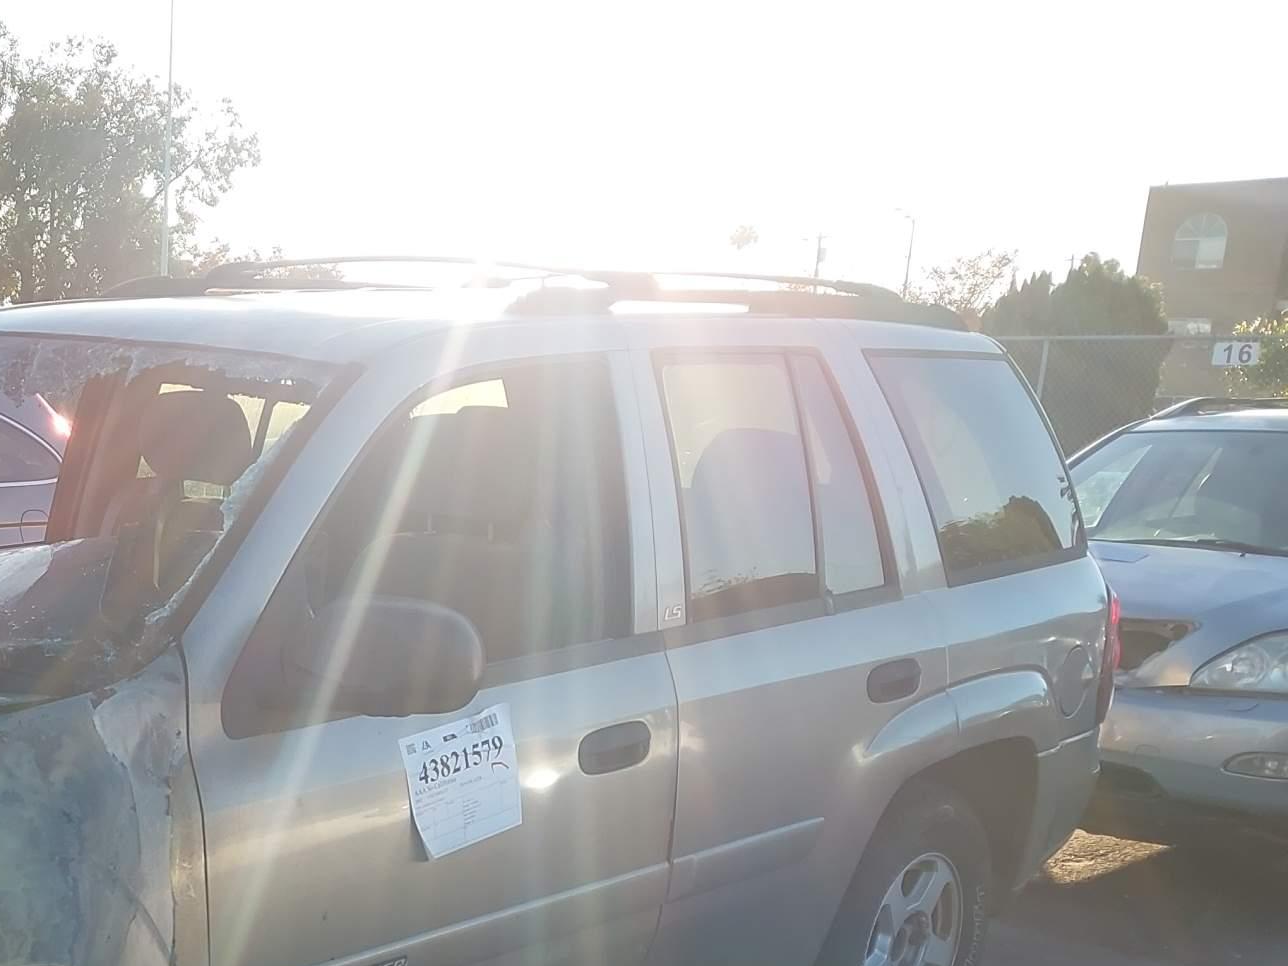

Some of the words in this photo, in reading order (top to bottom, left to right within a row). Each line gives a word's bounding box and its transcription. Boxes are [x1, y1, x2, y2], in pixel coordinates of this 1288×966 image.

[1223, 343, 1253, 364] 16
[664, 605, 682, 621] LS
[418, 735, 503, 785] 43821579
